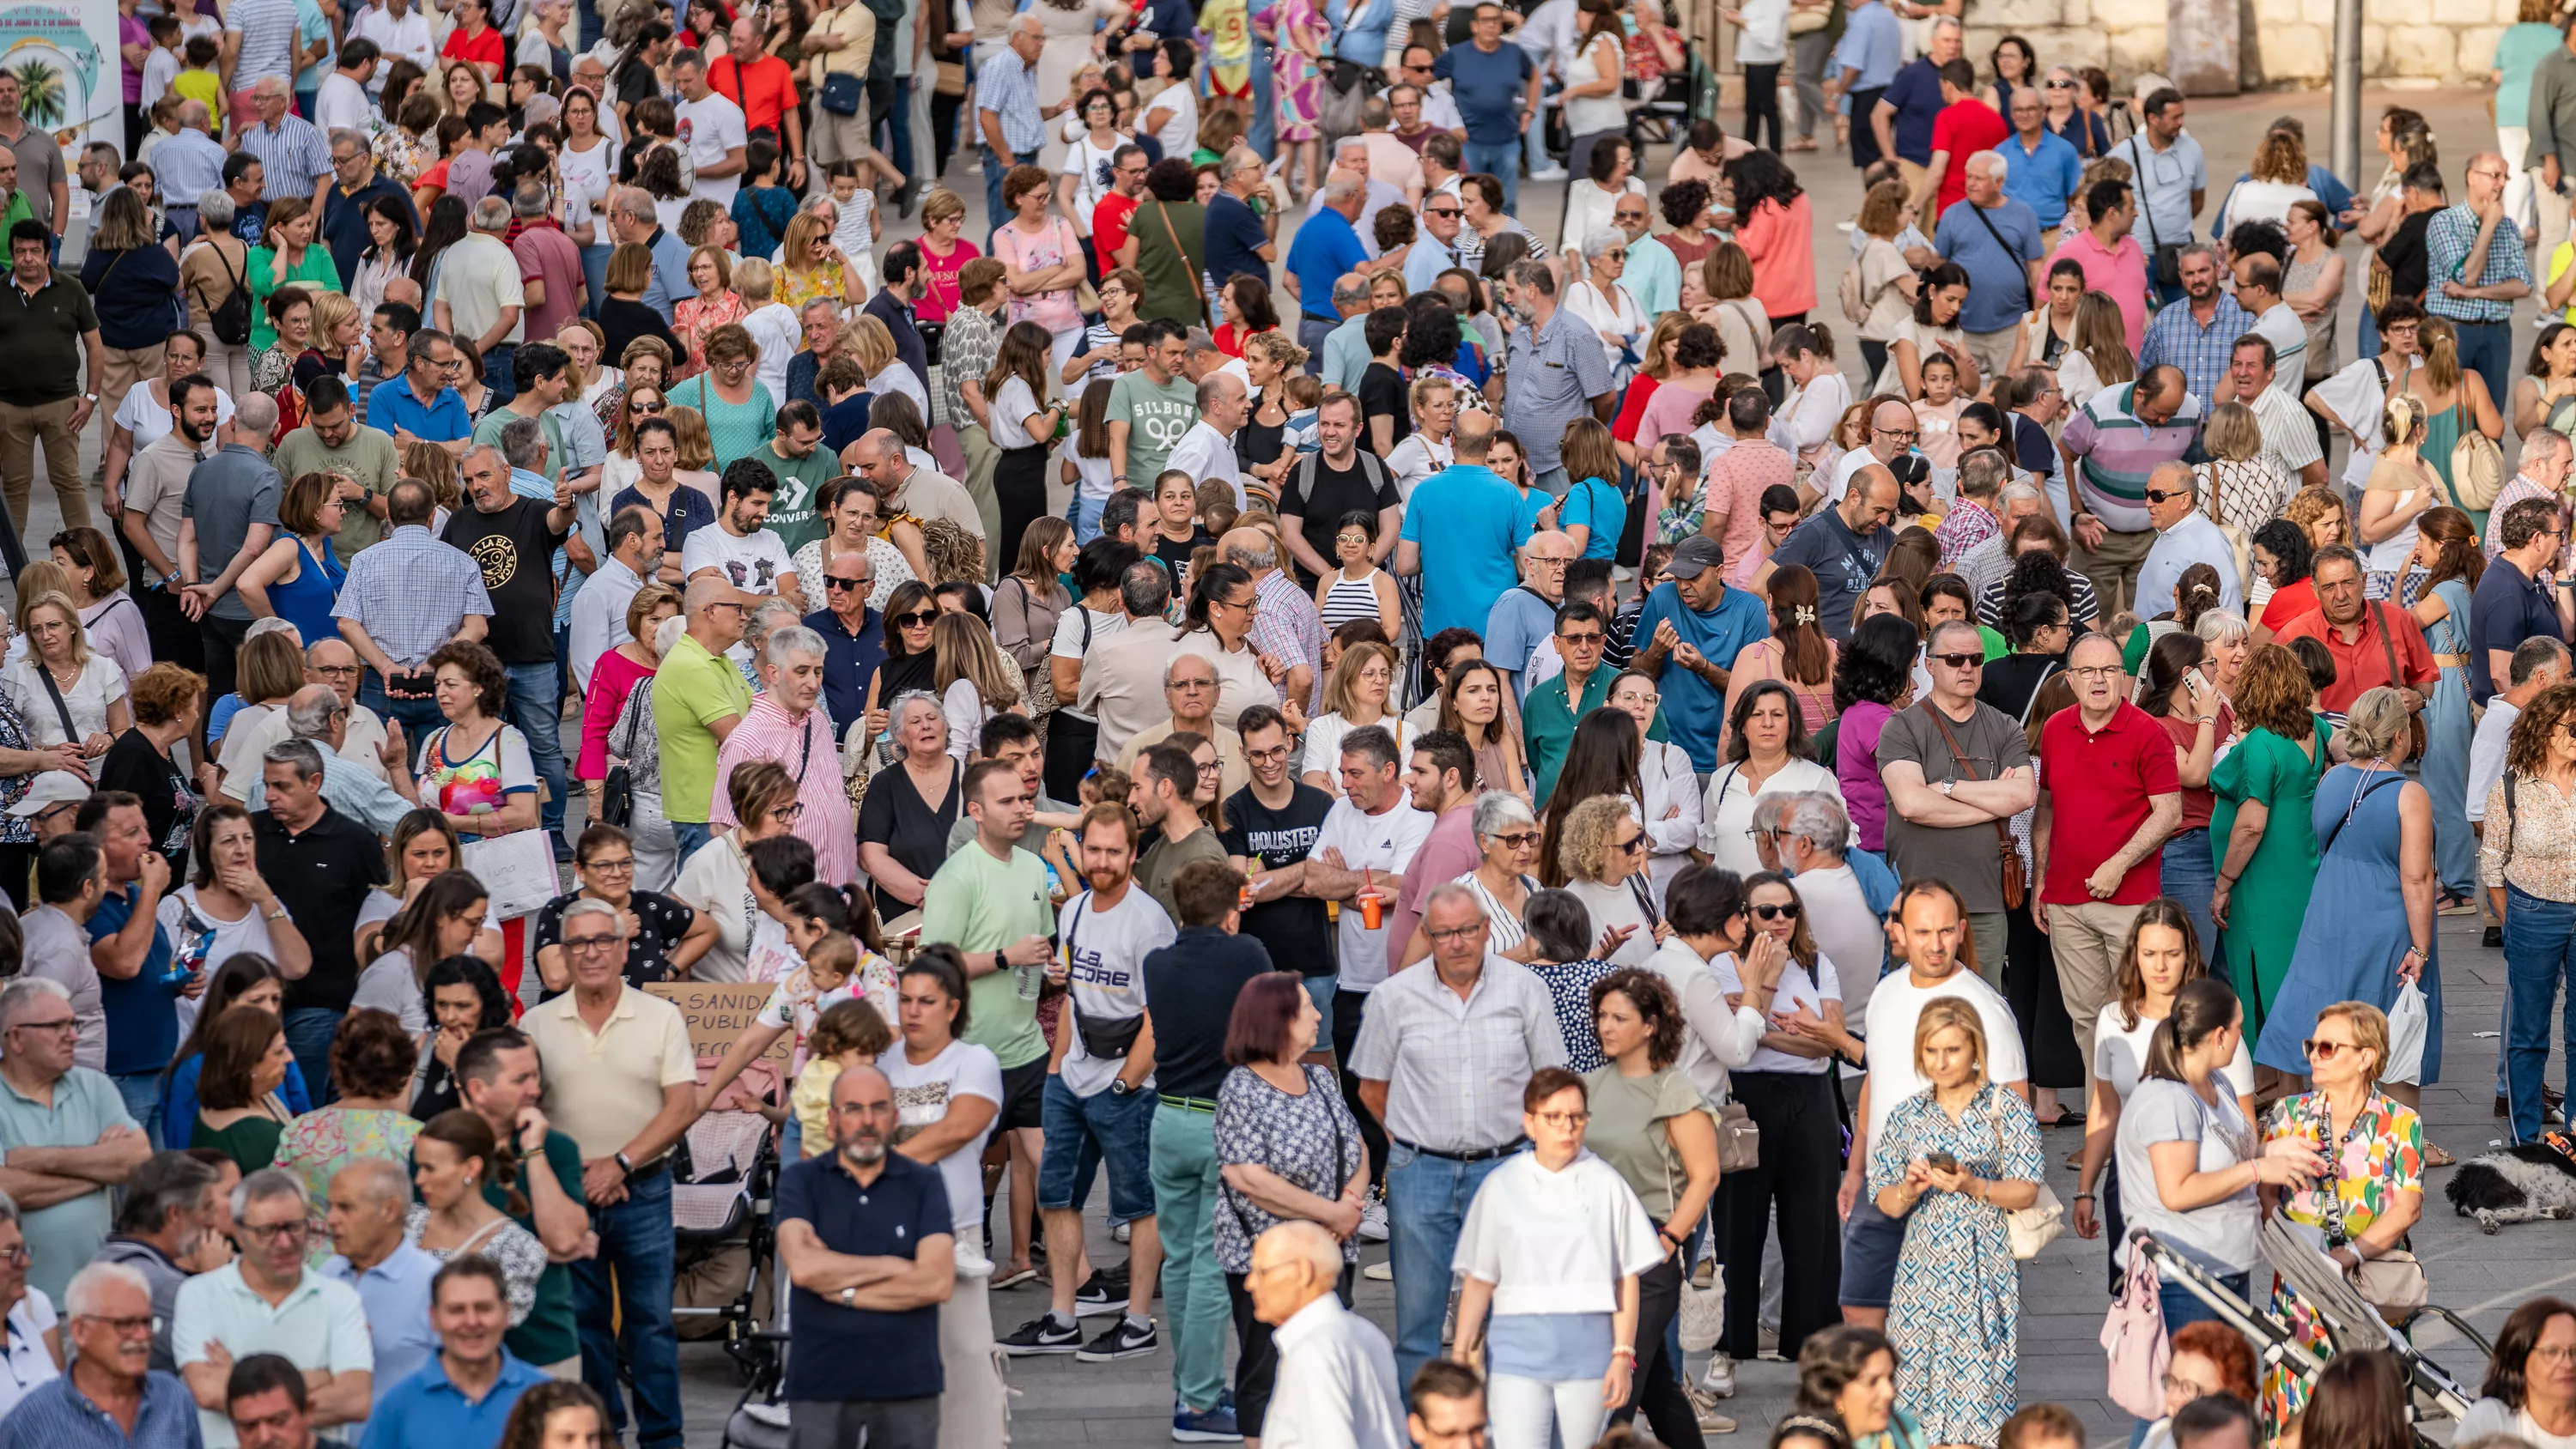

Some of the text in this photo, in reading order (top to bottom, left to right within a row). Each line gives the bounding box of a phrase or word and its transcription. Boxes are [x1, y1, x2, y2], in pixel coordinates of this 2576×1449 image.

[13, 4, 81, 15] VERANO
[1225, 16, 1242, 41] 9
[1133, 401, 1194, 418] SILBON
[1840, 549, 1880, 571] MIHTY
[1846, 578, 1870, 590] BLU
[1248, 826, 1319, 851] HOLLISTER
[688, 993, 772, 1011] SANIDA
[686, 1015, 757, 1029] PUBLI
